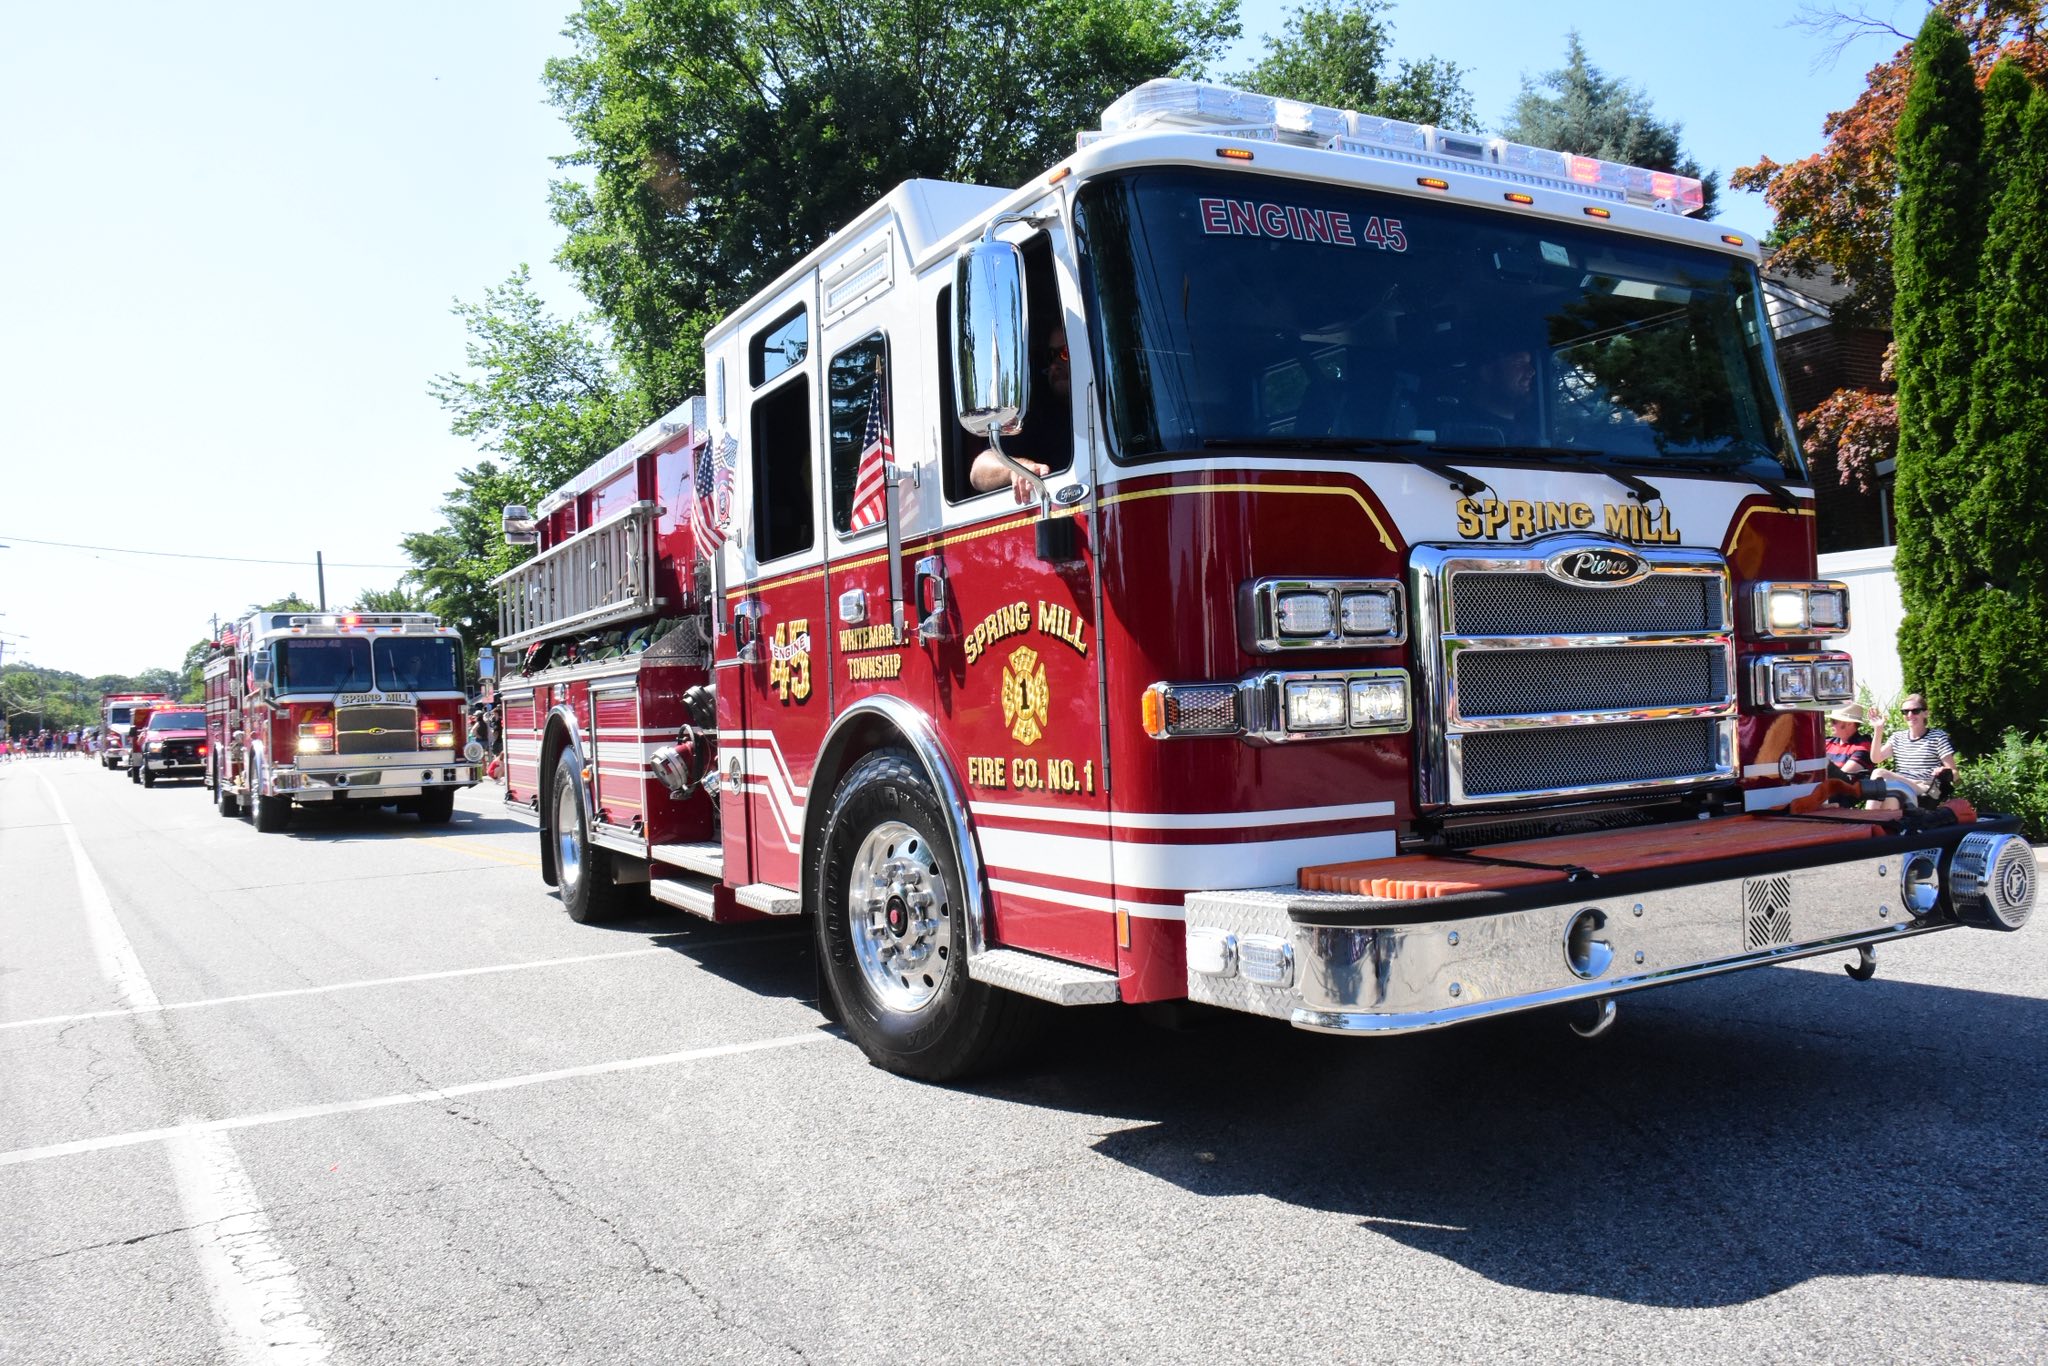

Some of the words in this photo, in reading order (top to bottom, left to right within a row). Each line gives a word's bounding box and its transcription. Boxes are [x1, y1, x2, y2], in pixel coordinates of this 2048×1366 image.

[1199, 198, 1357, 247] ENGINE
[1363, 216, 1408, 252] 45
[1456, 498, 1595, 541] SPRING
[1603, 504, 1681, 545] MILL
[1572, 552, 1630, 579] Pierce
[773, 635, 806, 660] ENGINE
[839, 620, 910, 652] WHITEMAR
[964, 601, 1032, 666] SPRING
[1038, 600, 1088, 656] MILL
[770, 619, 811, 704] 45
[847, 653, 902, 681] TOWNSHIP
[342, 694, 382, 705] SPRING
[386, 693, 411, 703] MILL
[1019, 678, 1030, 710] 1
[968, 756, 1006, 788] FIRE
[1012, 758, 1044, 790] CO.
[1047, 758, 1081, 792] NO.
[1083, 760, 1095, 793] 1
